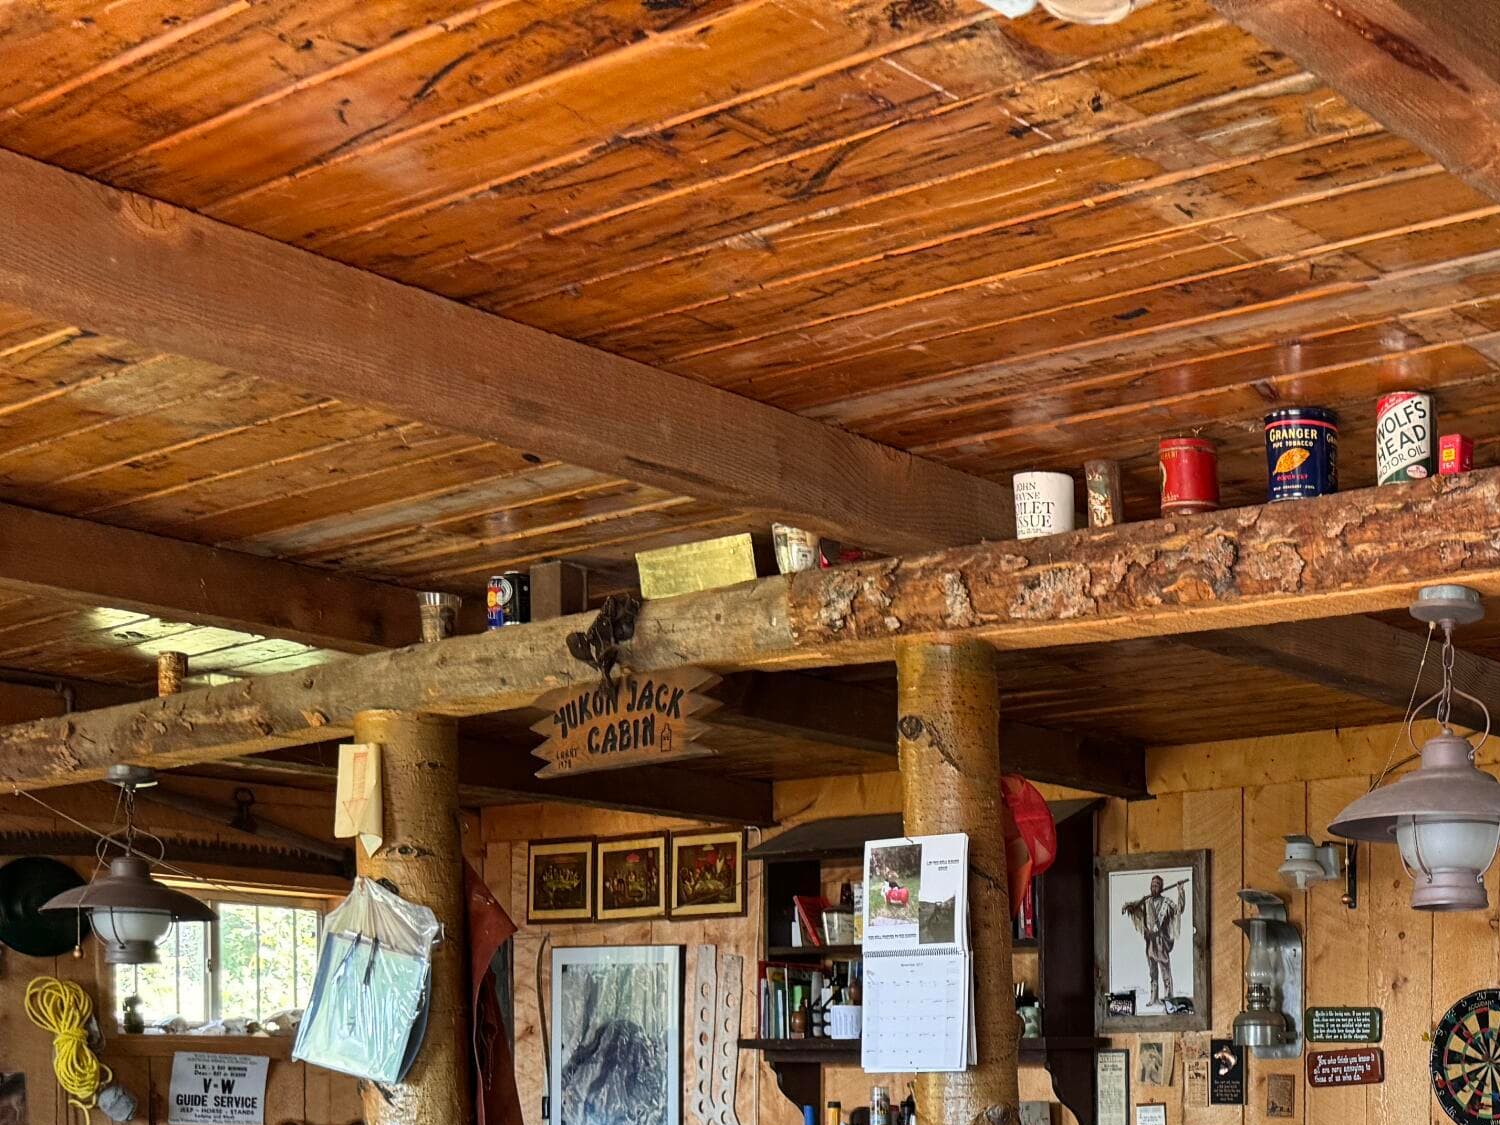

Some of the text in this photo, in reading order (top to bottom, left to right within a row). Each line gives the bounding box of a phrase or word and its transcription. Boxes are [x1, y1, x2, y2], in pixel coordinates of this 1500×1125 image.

[1269, 428, 1318, 442] GRANGER
[1377, 400, 1427, 445] WOLF'S
[1285, 440, 1314, 448] TOBACCO
[1377, 424, 1427, 466] HEAD
[1408, 445, 1427, 459] OIL
[553, 677, 685, 738] YUKON JACK
[588, 713, 655, 754] CABIN
[176, 1094, 258, 1109] GUIDE SERVICE
